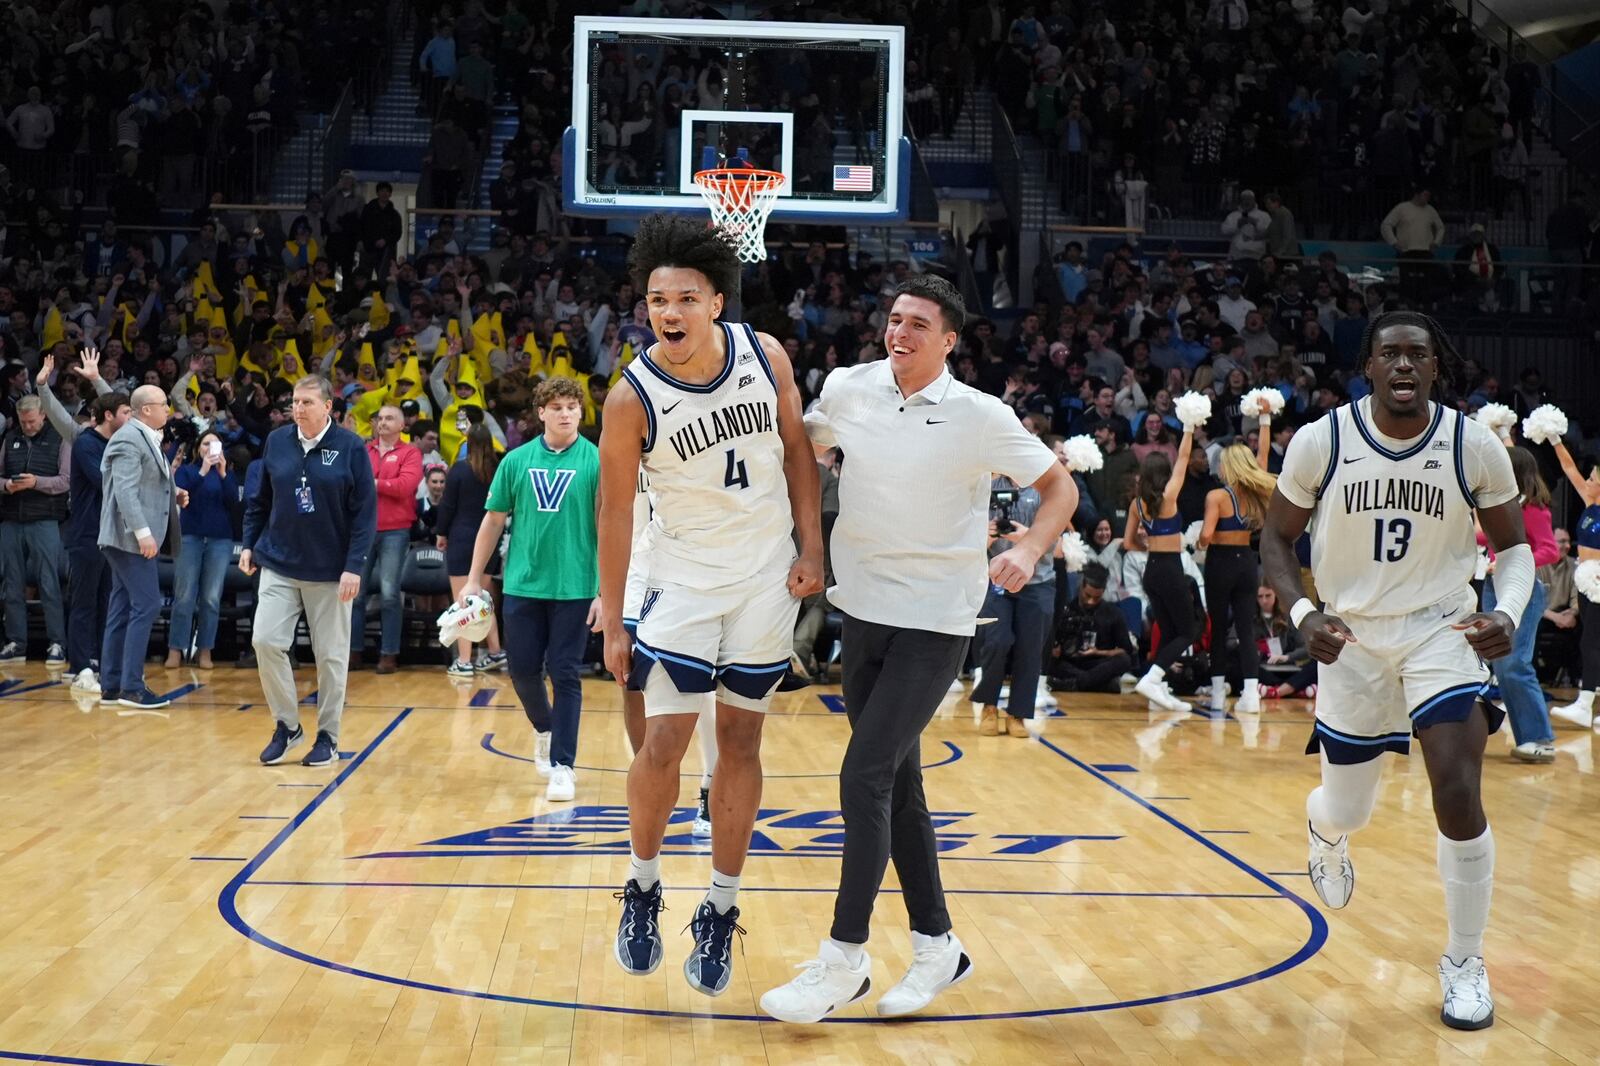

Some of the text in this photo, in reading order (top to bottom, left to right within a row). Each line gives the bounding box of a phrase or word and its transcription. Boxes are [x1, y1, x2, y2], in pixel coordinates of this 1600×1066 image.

[584, 196, 616, 204] SPALDING
[913, 242, 934, 251] 106
[669, 401, 773, 462] VILLANOVA
[321, 448, 340, 466] V
[724, 448, 751, 491] 4
[528, 468, 577, 512] V
[1344, 478, 1445, 521] VILLANOVA
[1373, 518, 1413, 563] 13
